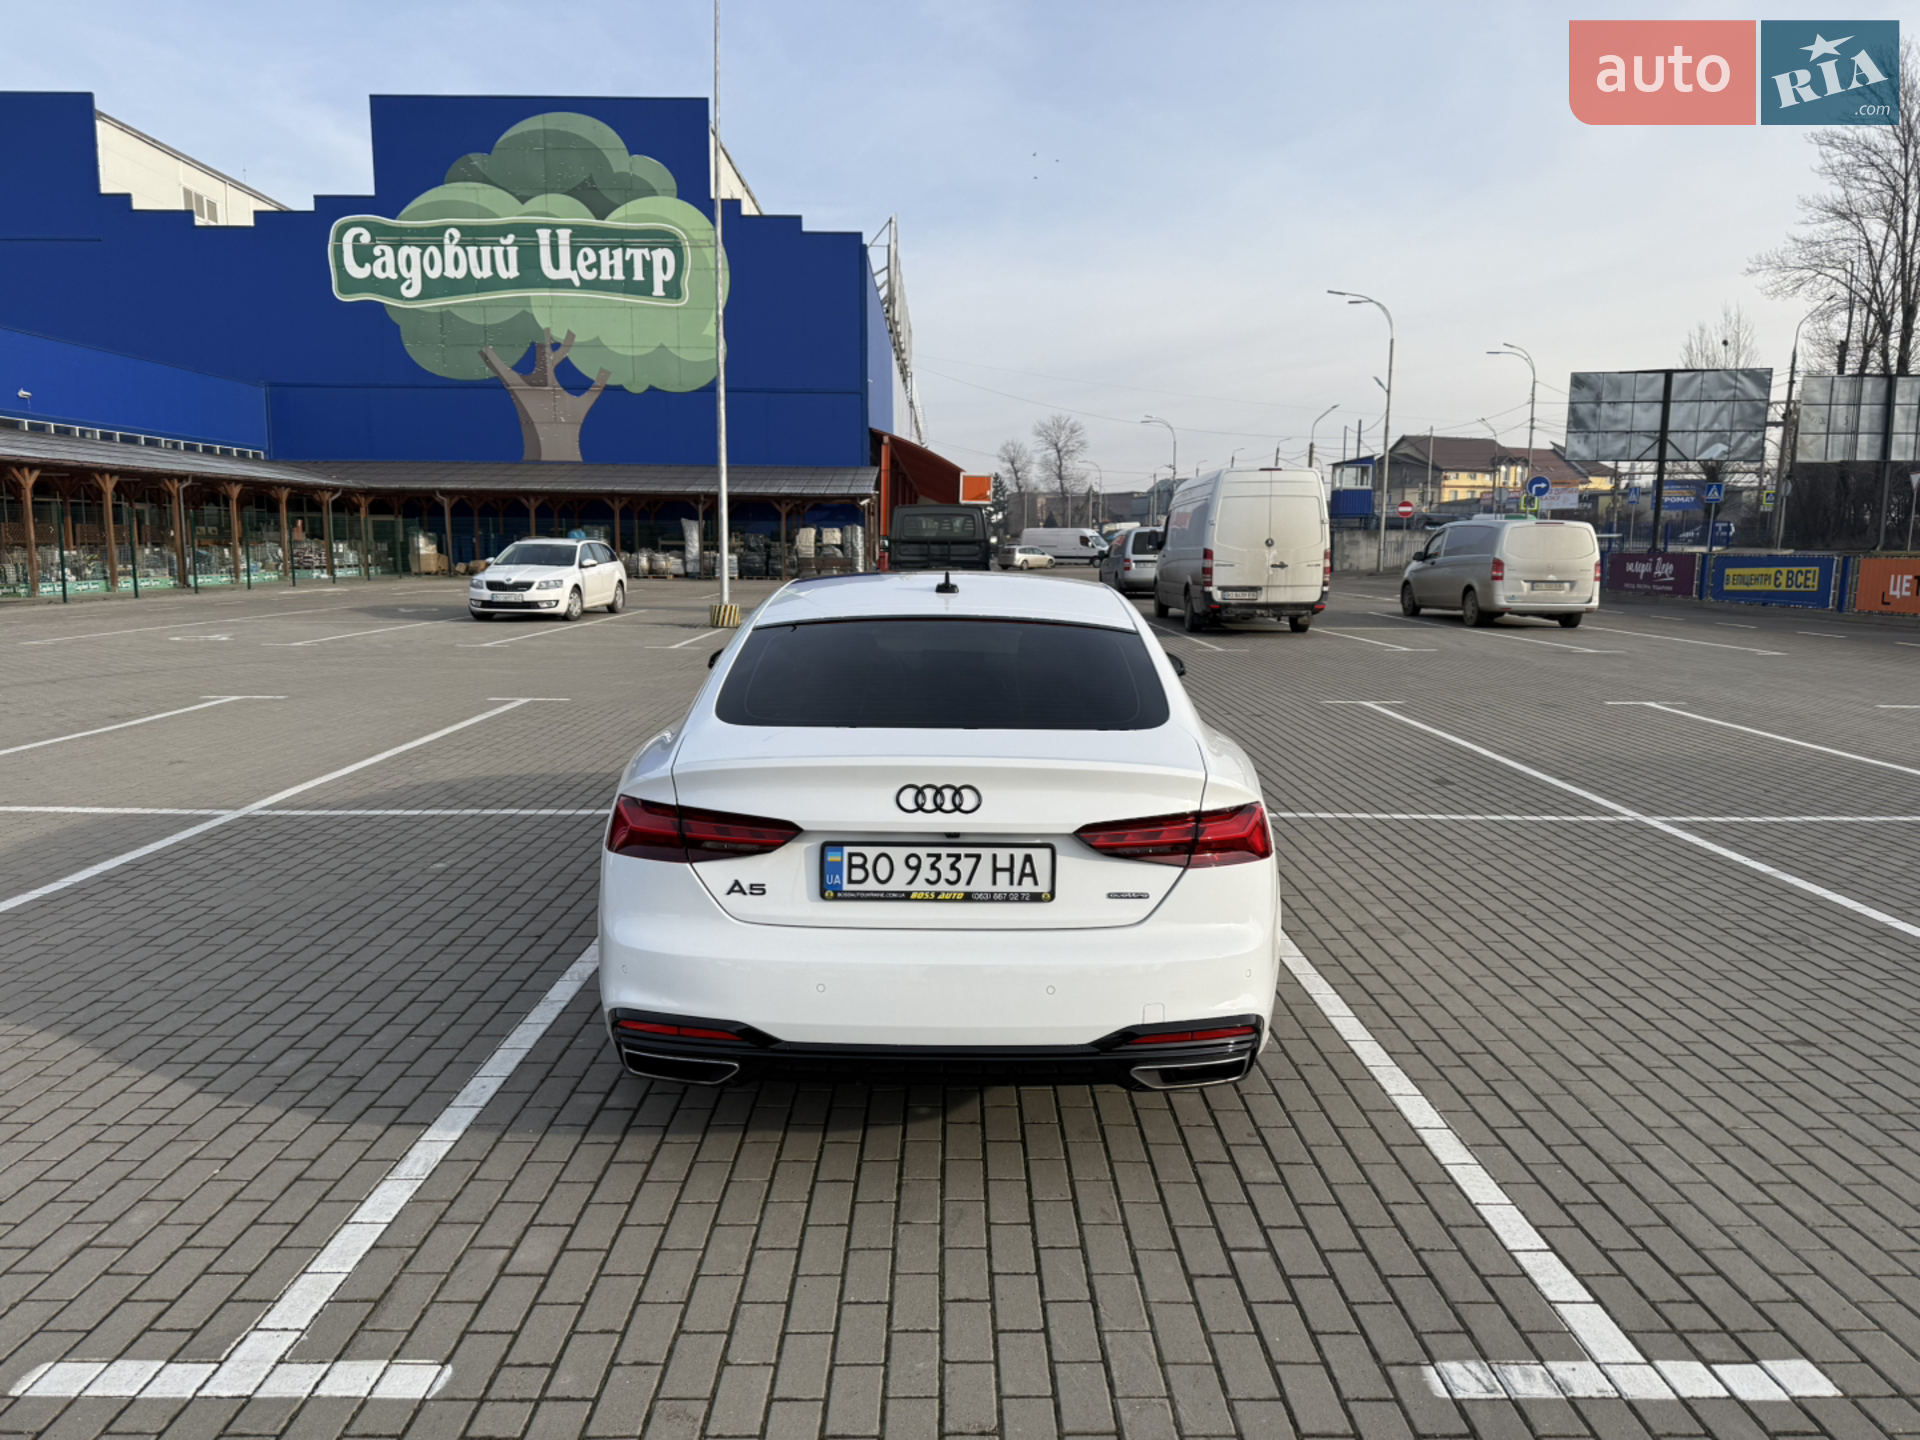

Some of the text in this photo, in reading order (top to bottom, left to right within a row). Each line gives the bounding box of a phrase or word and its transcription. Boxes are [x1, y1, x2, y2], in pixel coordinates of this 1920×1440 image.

[342, 226, 676, 298] Садовий Центр
[1732, 573, 1771, 587] ЕПІЦЕНТРІ
[1773, 569, 1782, 588] Є
[1786, 569, 1817, 589] ВСЕ!
[846, 851, 1039, 886] BO 9337 HA
[726, 879, 767, 896] A5
[826, 874, 841, 885] UA
[910, 891, 935, 900] BOSS
[937, 892, 965, 900] AUTO
[993, 893, 1007, 901] 667
[1009, 893, 1019, 901] 02
[1020, 893, 1031, 901] 72
